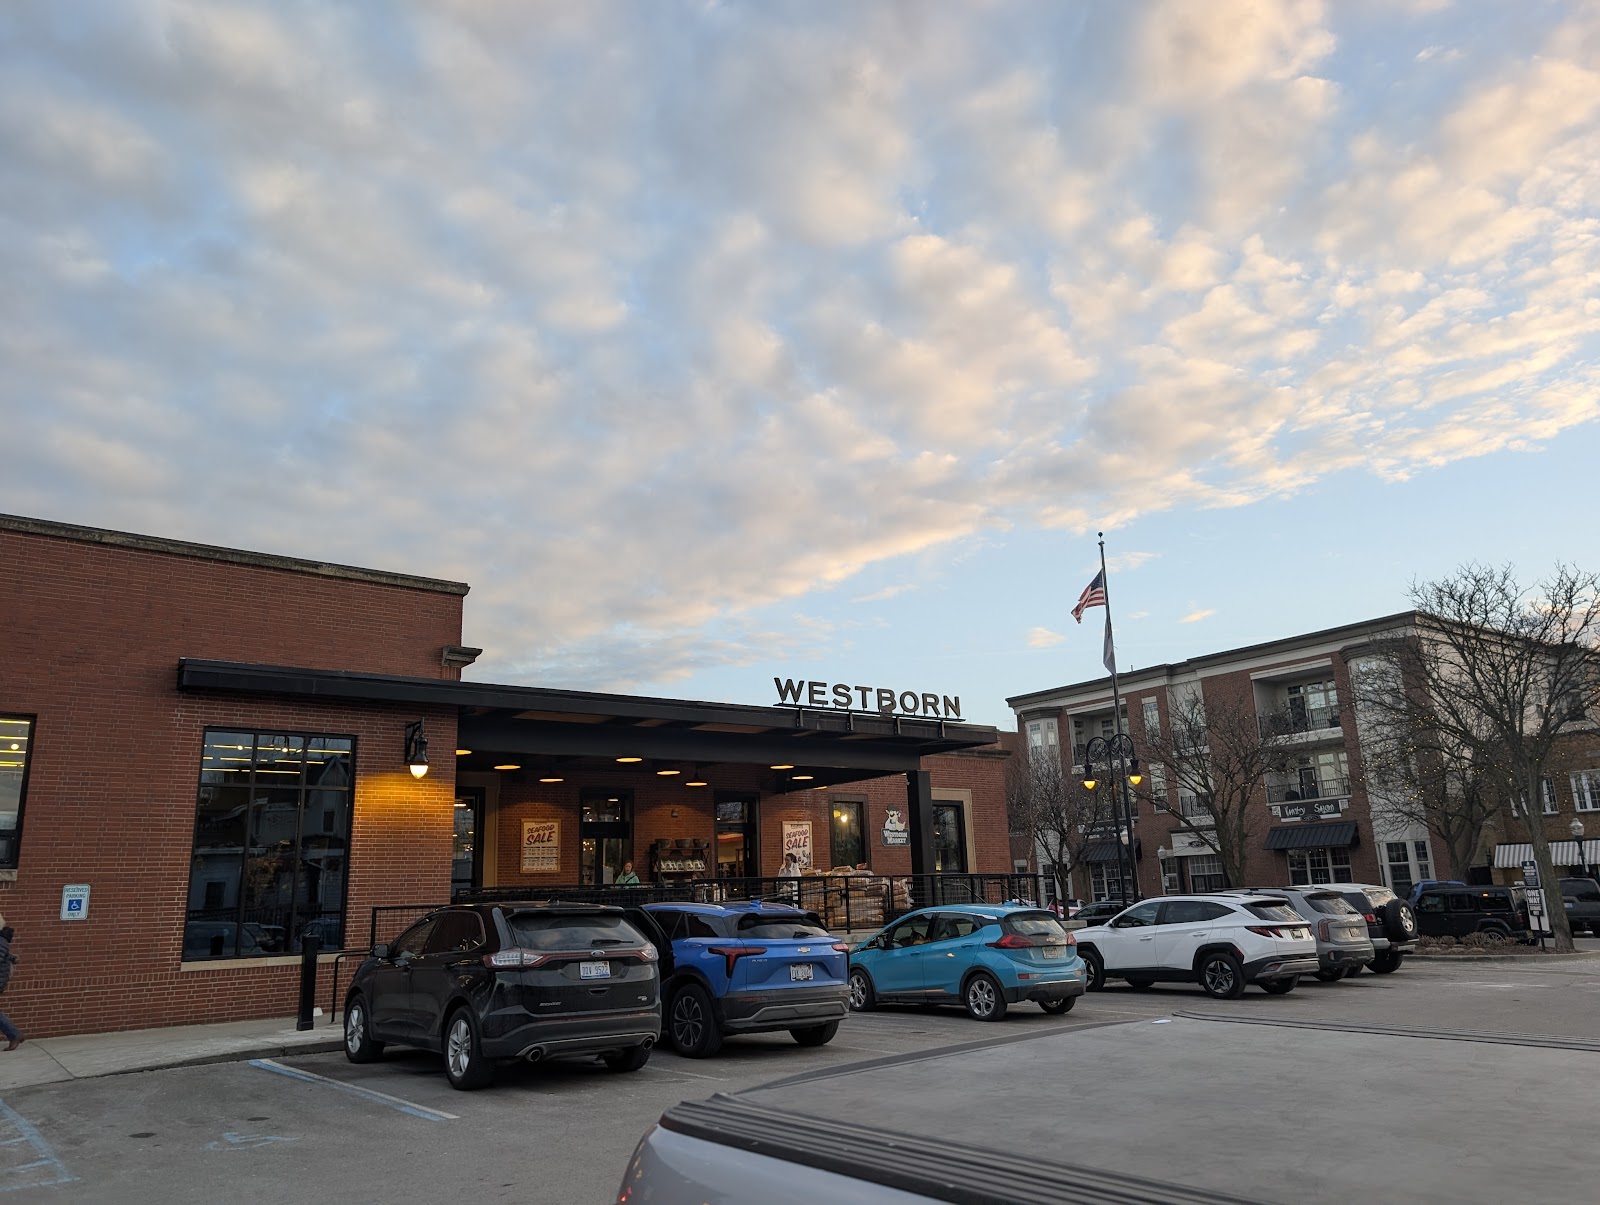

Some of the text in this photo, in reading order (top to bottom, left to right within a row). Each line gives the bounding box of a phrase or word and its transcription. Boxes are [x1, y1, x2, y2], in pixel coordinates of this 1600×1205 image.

[773, 677, 961, 717] WESTBORN
[526, 824, 555, 834] SEAFOOD
[785, 829, 809, 839] SEAFOOD
[525, 830, 556, 846] SALE
[785, 836, 810, 851] SALE
[1526, 889, 1540, 897] ONE
